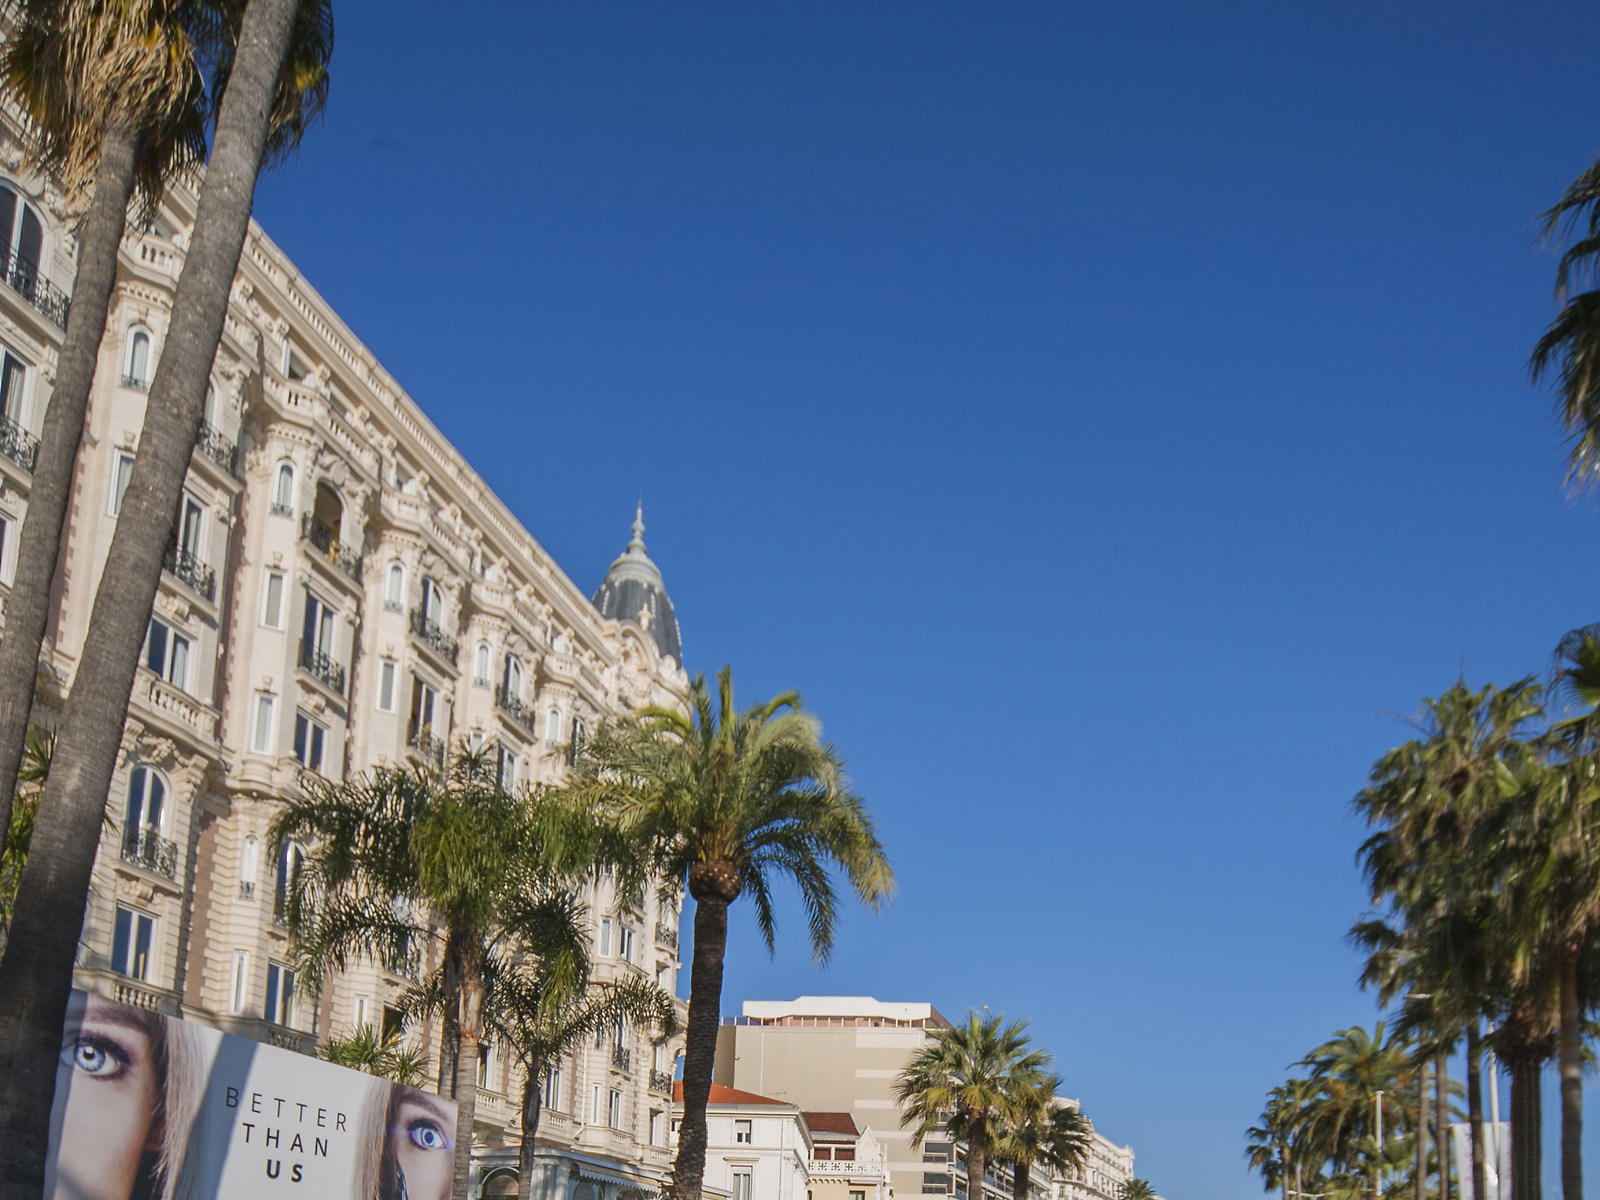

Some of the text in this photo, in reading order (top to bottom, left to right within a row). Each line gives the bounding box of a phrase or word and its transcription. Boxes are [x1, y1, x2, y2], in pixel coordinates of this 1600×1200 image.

[226, 1086, 347, 1132] BETTER
[242, 1122, 328, 1157] THAN
[266, 1158, 303, 1183] US
